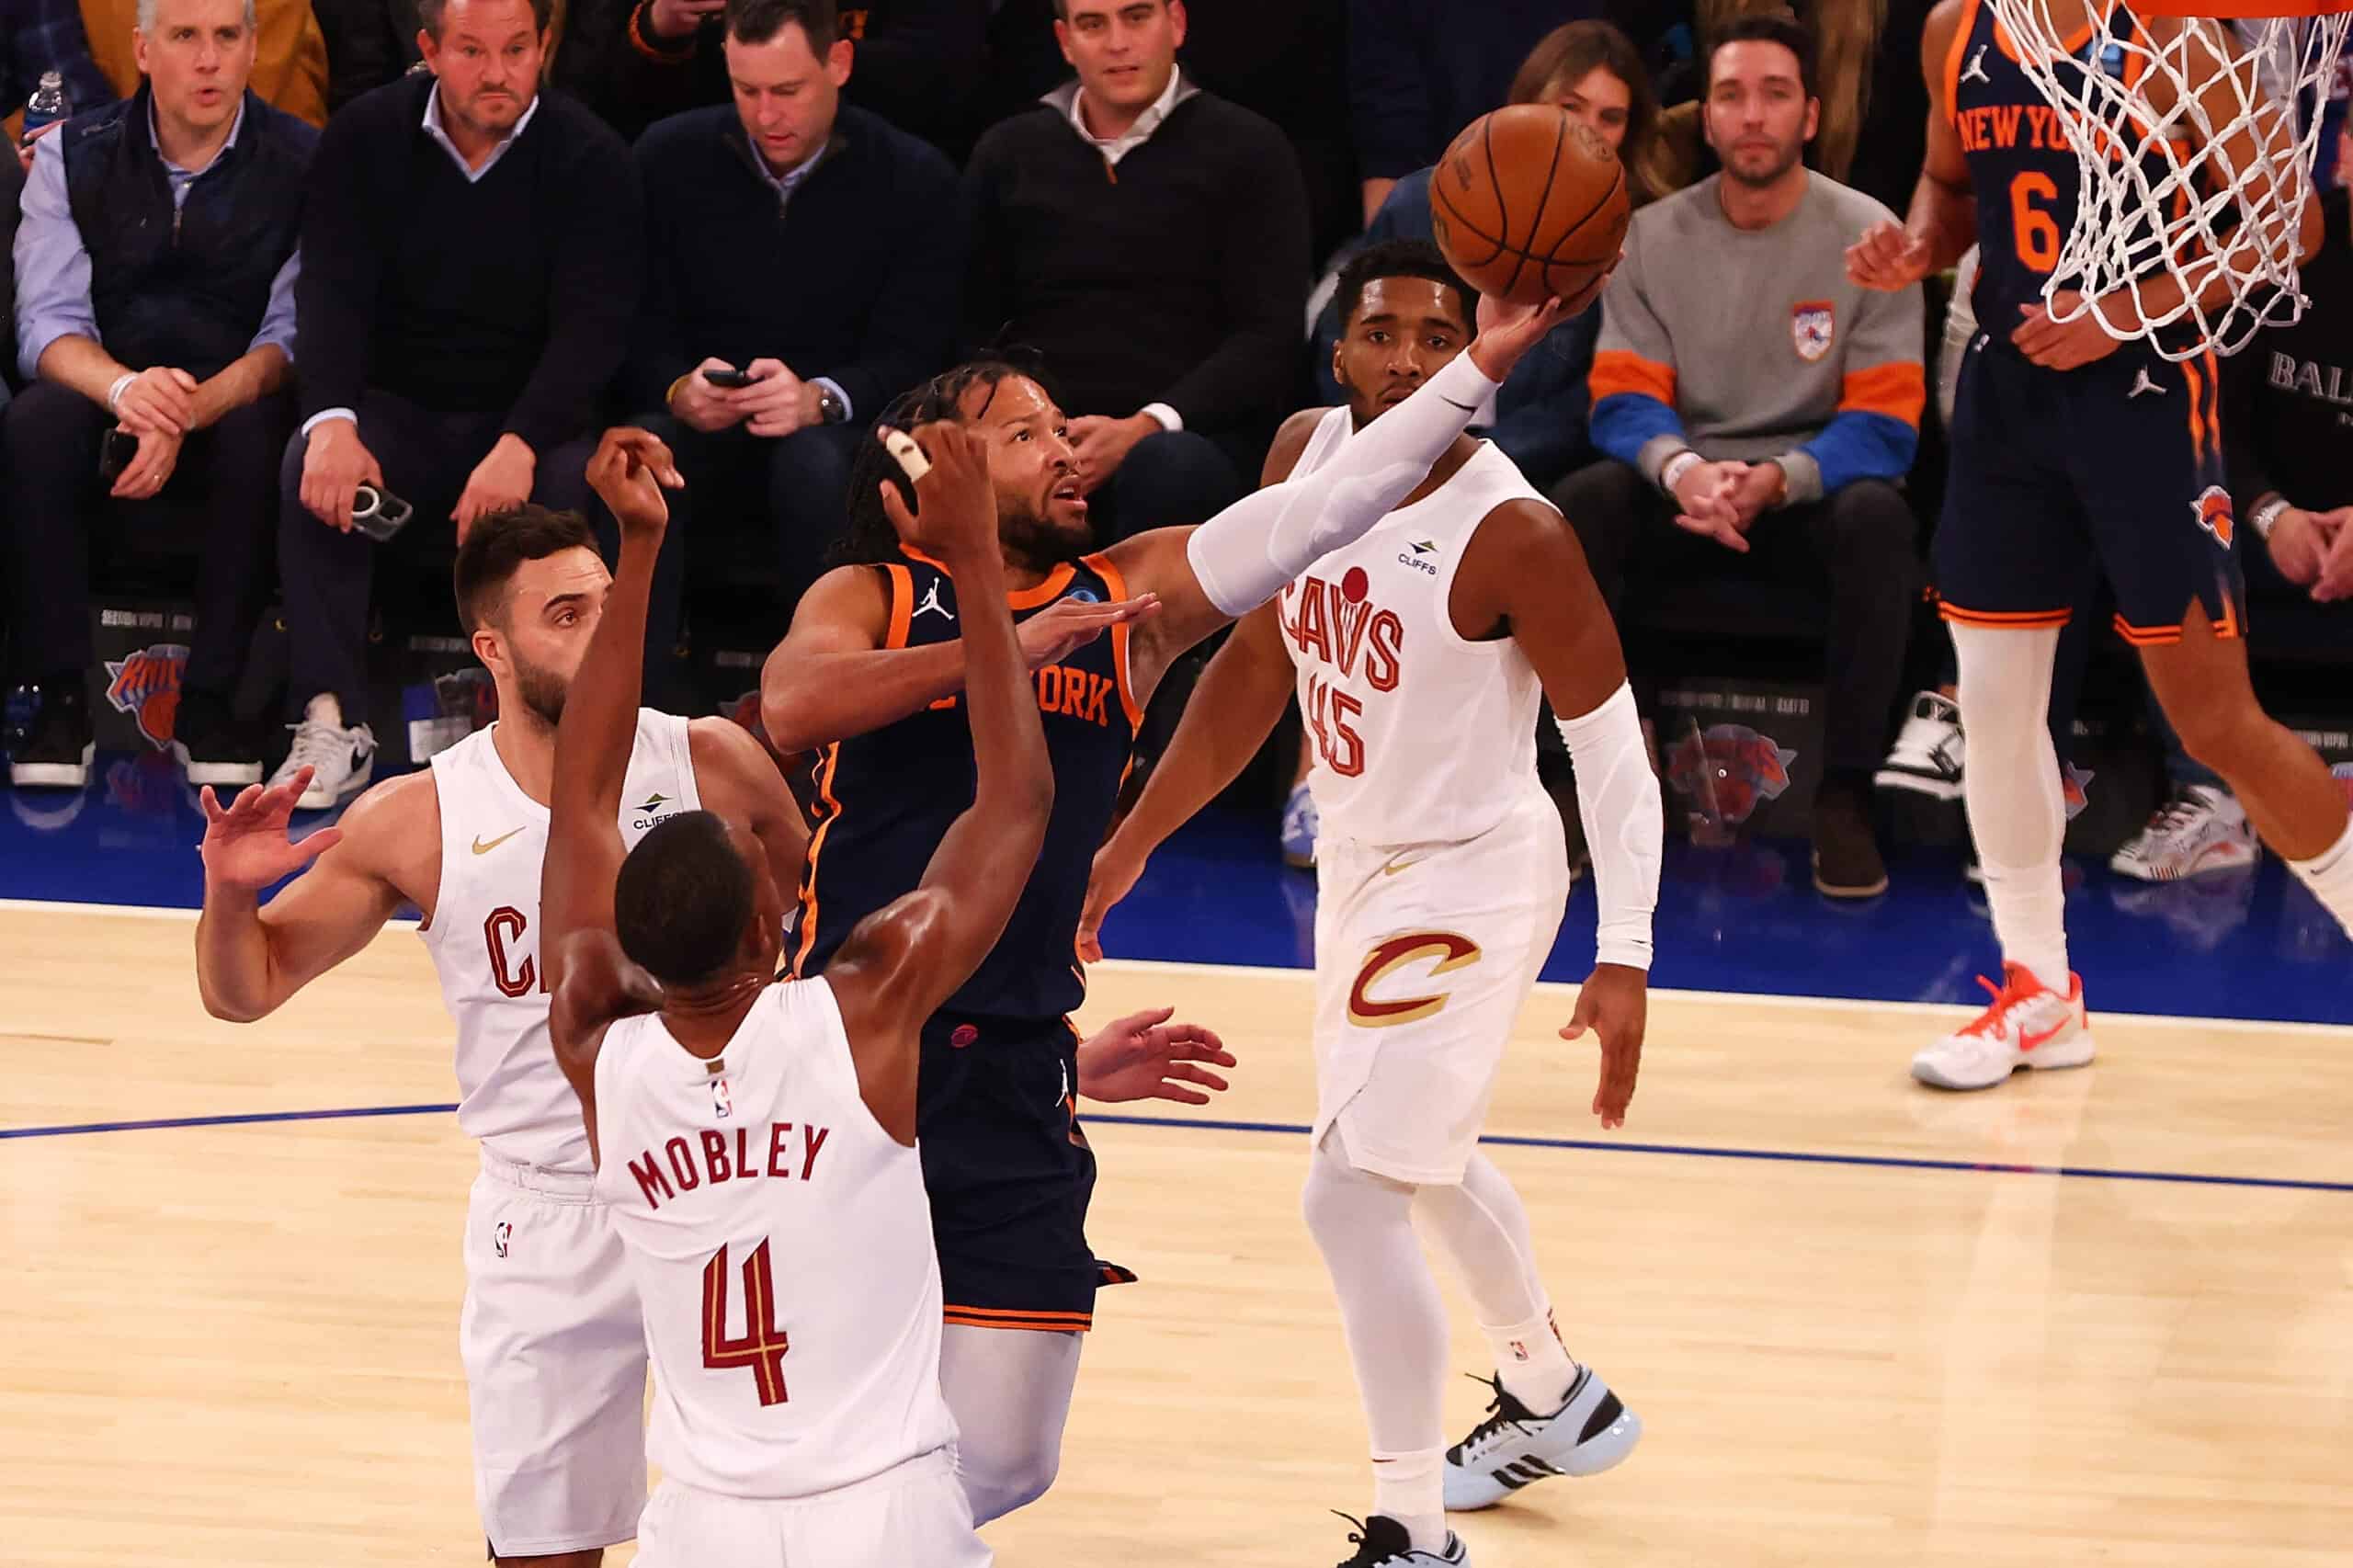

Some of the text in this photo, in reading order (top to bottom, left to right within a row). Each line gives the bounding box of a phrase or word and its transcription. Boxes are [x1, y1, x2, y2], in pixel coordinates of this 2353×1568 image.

[1957, 105, 2022, 153] NEW
[2009, 171, 2060, 273] 6
[2270, 351, 2353, 404] BAL
[1398, 553, 1437, 575] CLIFFS
[1275, 567, 1404, 693] CAVS
[1029, 664, 1113, 727] ORK
[1308, 672, 1365, 778] 45
[627, 1122, 829, 1210] MOBLEY
[701, 1234, 790, 1407] 4
